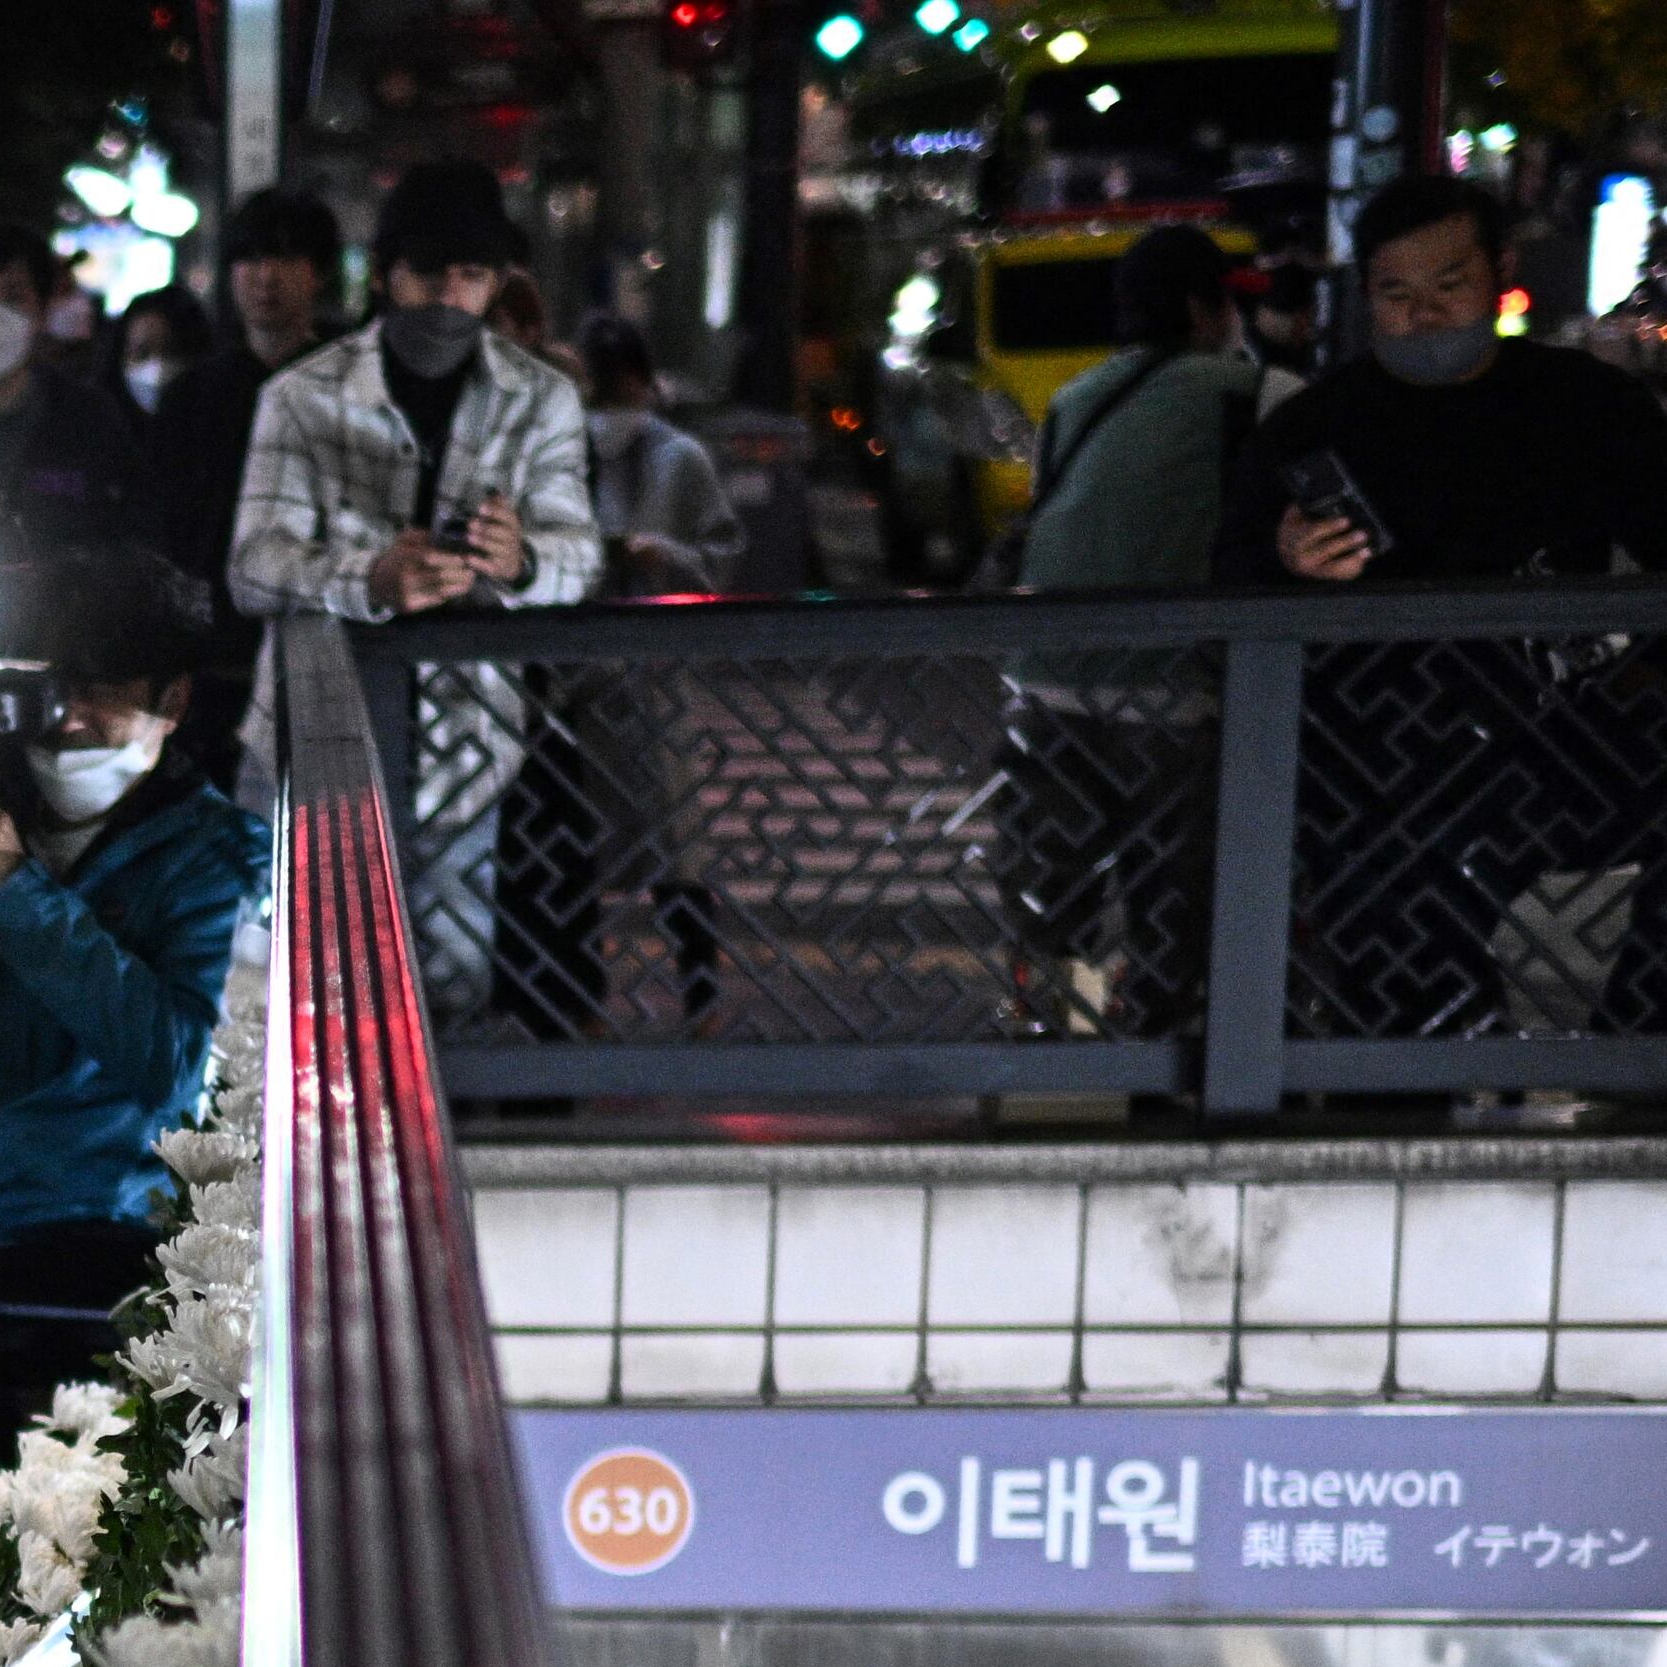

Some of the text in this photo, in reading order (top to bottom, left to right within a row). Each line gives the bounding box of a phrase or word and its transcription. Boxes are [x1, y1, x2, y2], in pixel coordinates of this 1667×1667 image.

[1242, 1460, 1462, 1508] Itaewon
[577, 1484, 679, 1537] 630
[881, 1455, 1200, 1573] 이태원
[1242, 1520, 1389, 1568] 梨泰院
[1433, 1523, 1650, 1569] イテウォン
